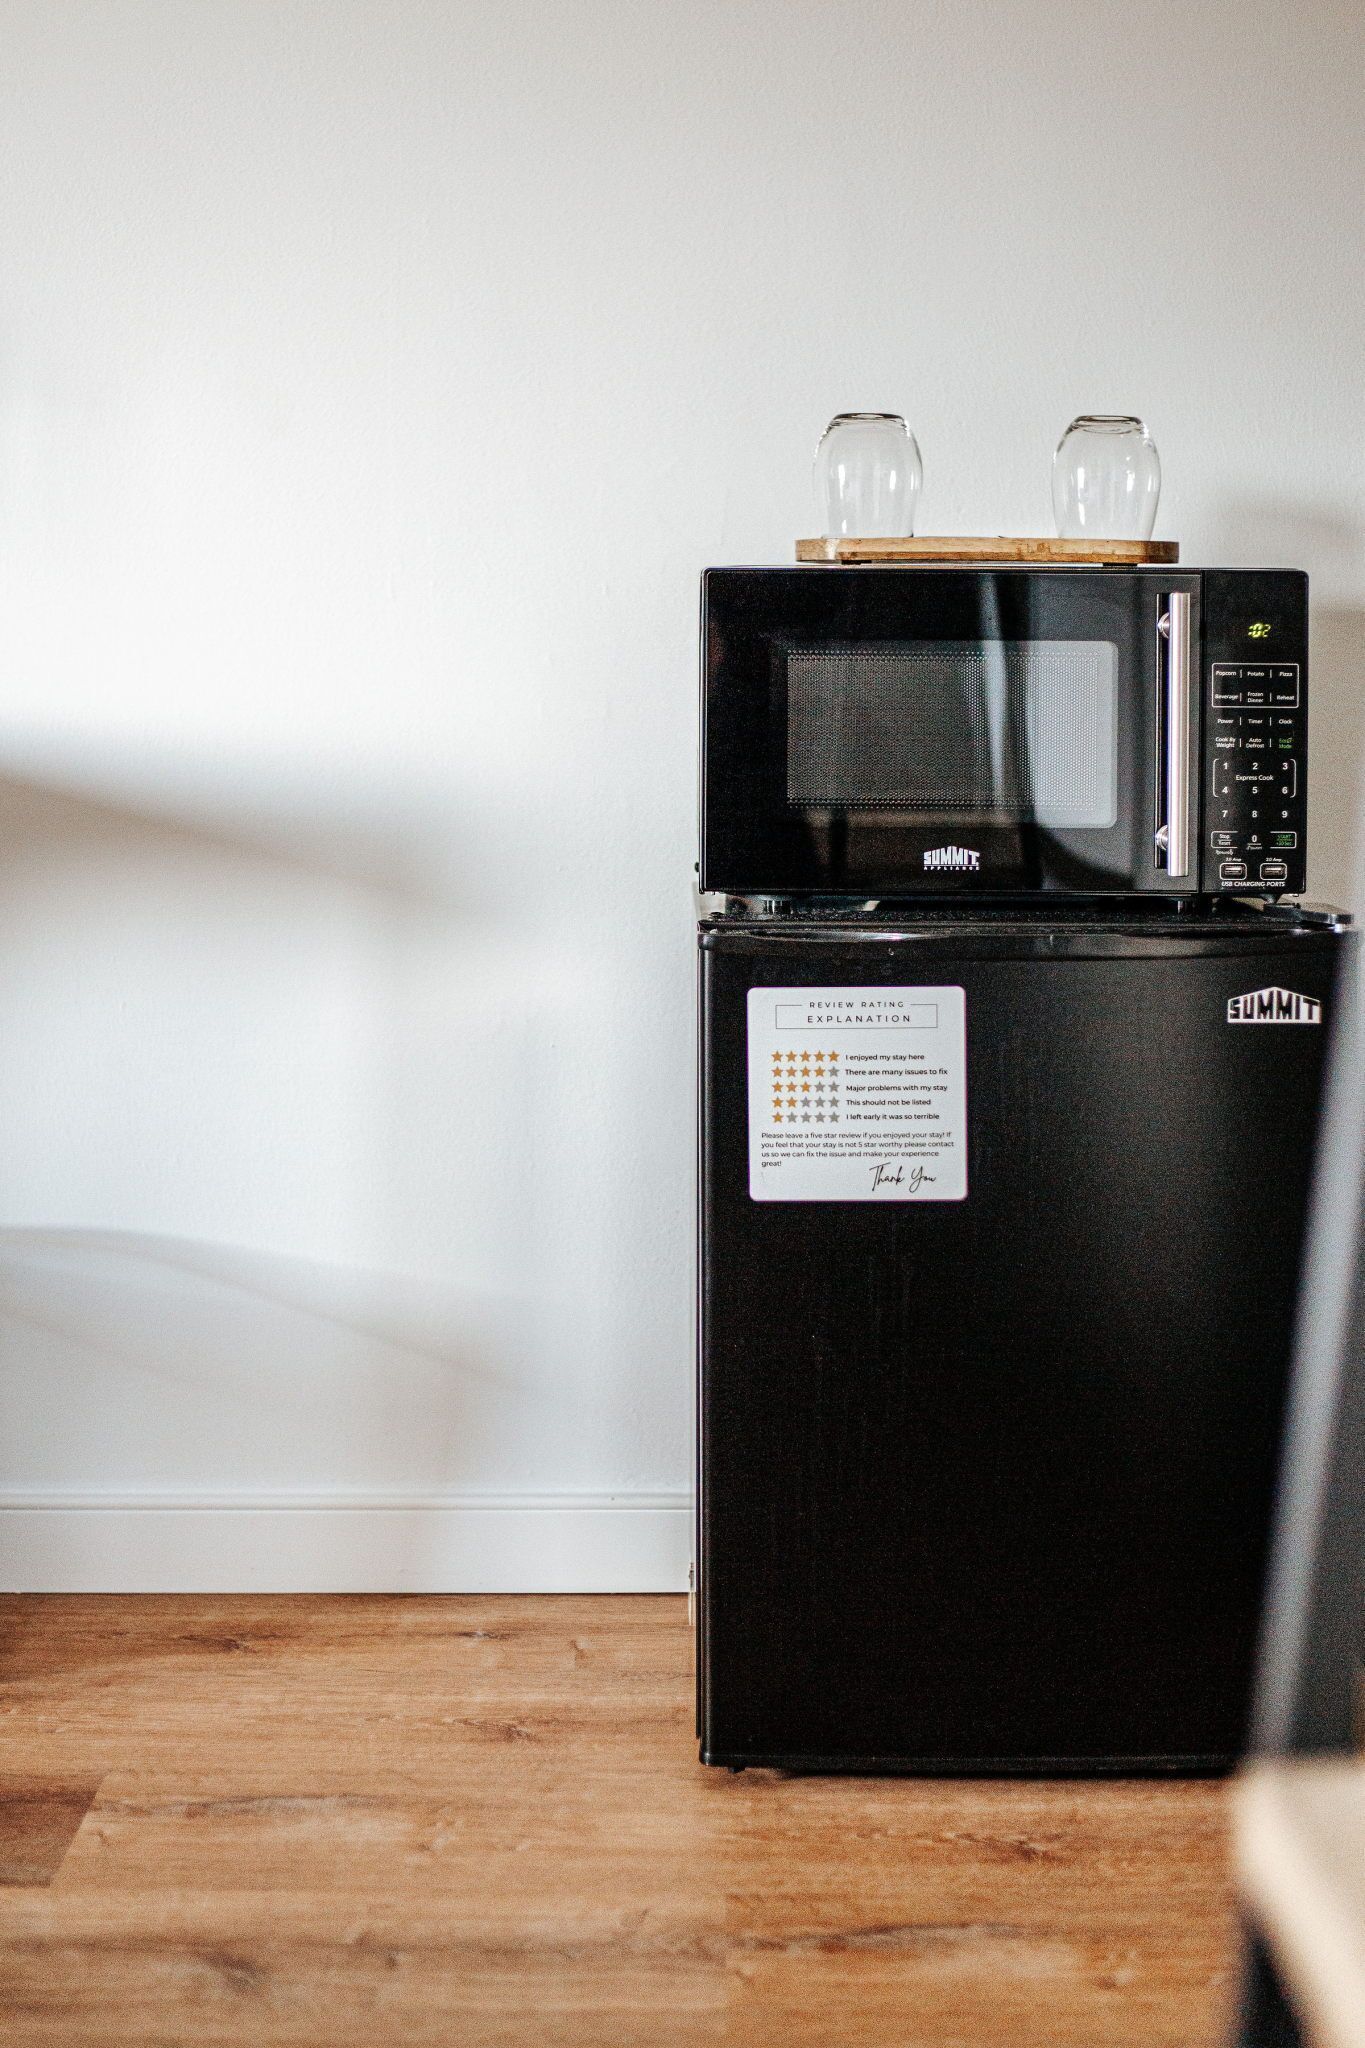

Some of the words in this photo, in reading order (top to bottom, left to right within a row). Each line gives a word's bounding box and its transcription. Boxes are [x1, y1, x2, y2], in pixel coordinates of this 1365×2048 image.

[924, 846, 980, 865] SUMMIT
[1228, 988, 1321, 1022] SUMMIT
[808, 1015, 910, 1023] EXPLANATION
[869, 1162, 905, 1191] Thank
[909, 1166, 936, 1193] You
